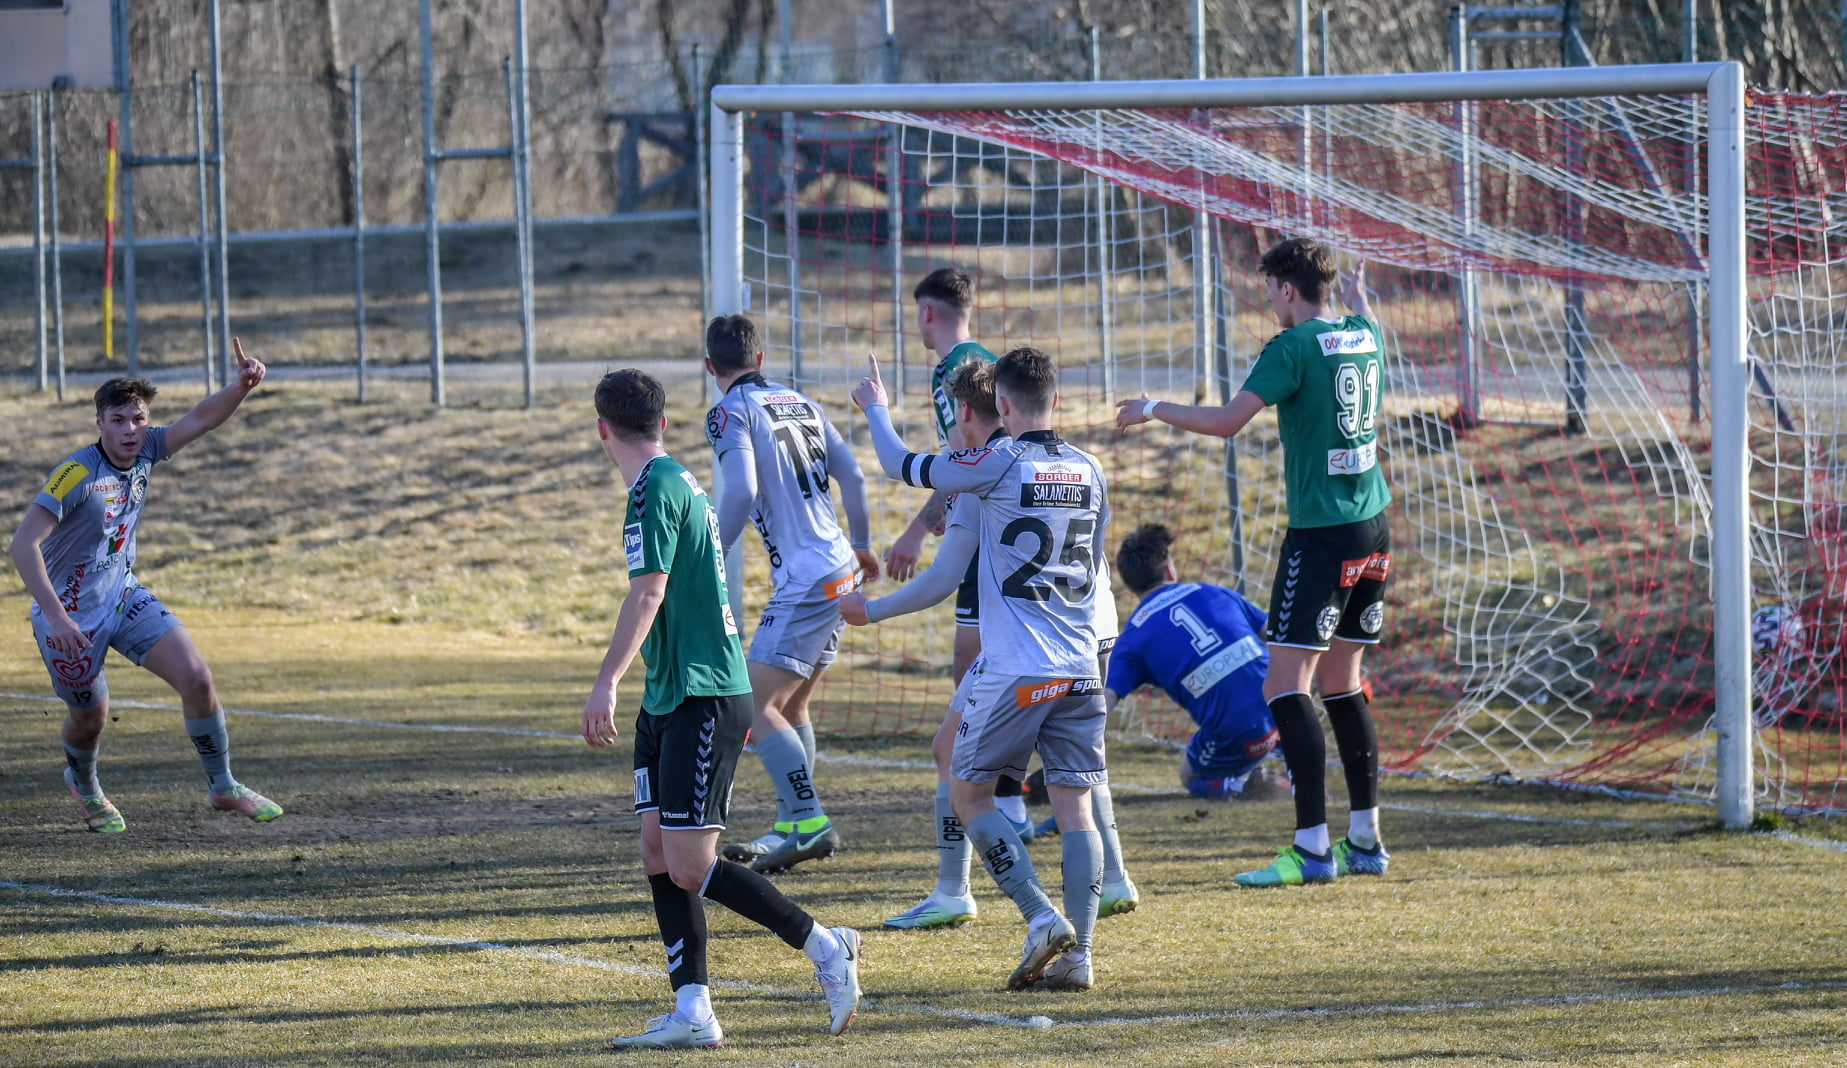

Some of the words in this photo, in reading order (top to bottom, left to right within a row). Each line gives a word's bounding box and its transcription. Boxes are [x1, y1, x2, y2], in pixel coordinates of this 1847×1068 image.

[1335, 360, 1380, 439] 91
[774, 425, 829, 499] 15
[1038, 473, 1080, 481] SORGER
[1033, 485, 1082, 502] SALANETTIS
[1000, 517, 1093, 602] 25
[1169, 602, 1223, 657] 1
[72, 690, 92, 704] 19
[1030, 682, 1069, 703] giga
[787, 764, 814, 801] OPEL
[985, 838, 1014, 875] OPEL
